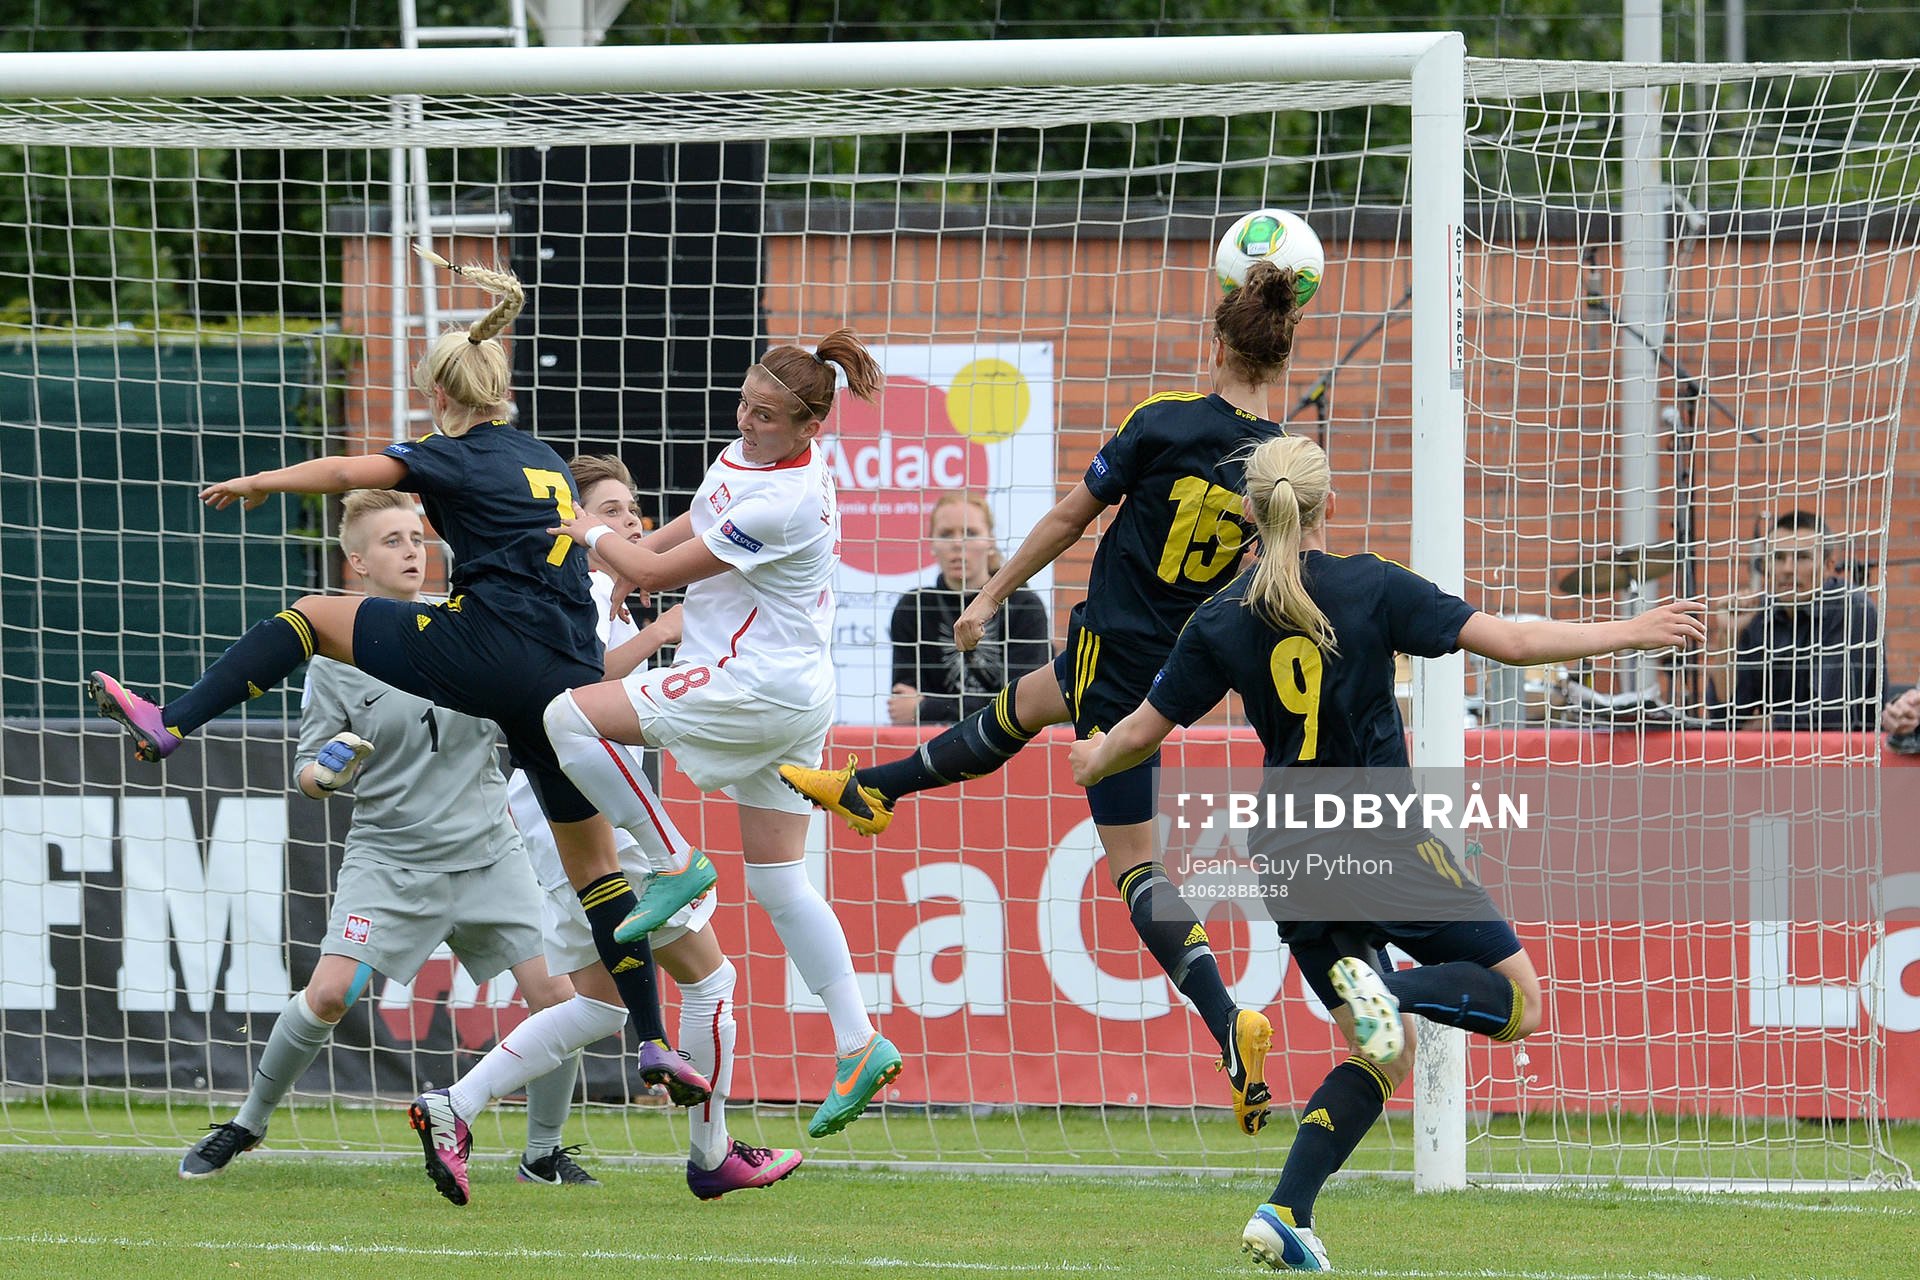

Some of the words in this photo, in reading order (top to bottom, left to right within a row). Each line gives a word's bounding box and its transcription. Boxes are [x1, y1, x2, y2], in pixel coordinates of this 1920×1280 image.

[1455, 224, 1463, 299] ACTIVA
[821, 431, 965, 488] Adac
[1092, 455, 1107, 475] SPECT
[523, 467, 576, 567] 7
[730, 531, 760, 552] RESPECT
[1157, 476, 1245, 584] 15
[837, 622, 874, 644] rts
[662, 667, 710, 699] 8
[1270, 636, 1323, 760] 9
[420, 707, 439, 752] 1
[0, 796, 289, 1013] FM
[422, 1093, 459, 1154] NIKE
